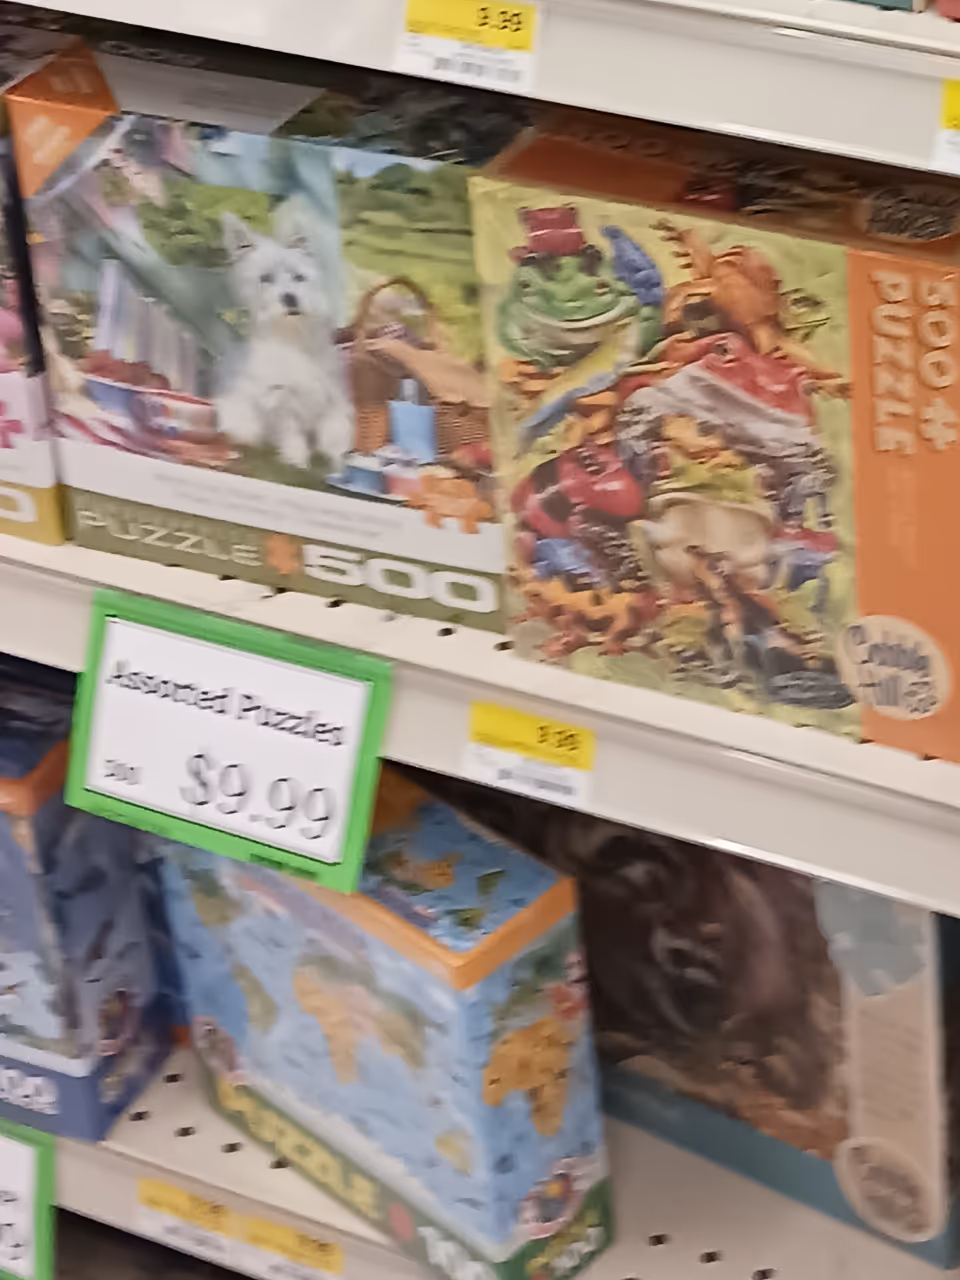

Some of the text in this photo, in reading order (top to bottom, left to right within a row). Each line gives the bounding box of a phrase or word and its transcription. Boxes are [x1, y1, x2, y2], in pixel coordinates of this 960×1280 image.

[77, 509, 264, 568] PUZZLE
[302, 543, 499, 614] 500
[104, 657, 348, 747] Assorted Puzzles
[177, 748, 338, 841] $9.99
